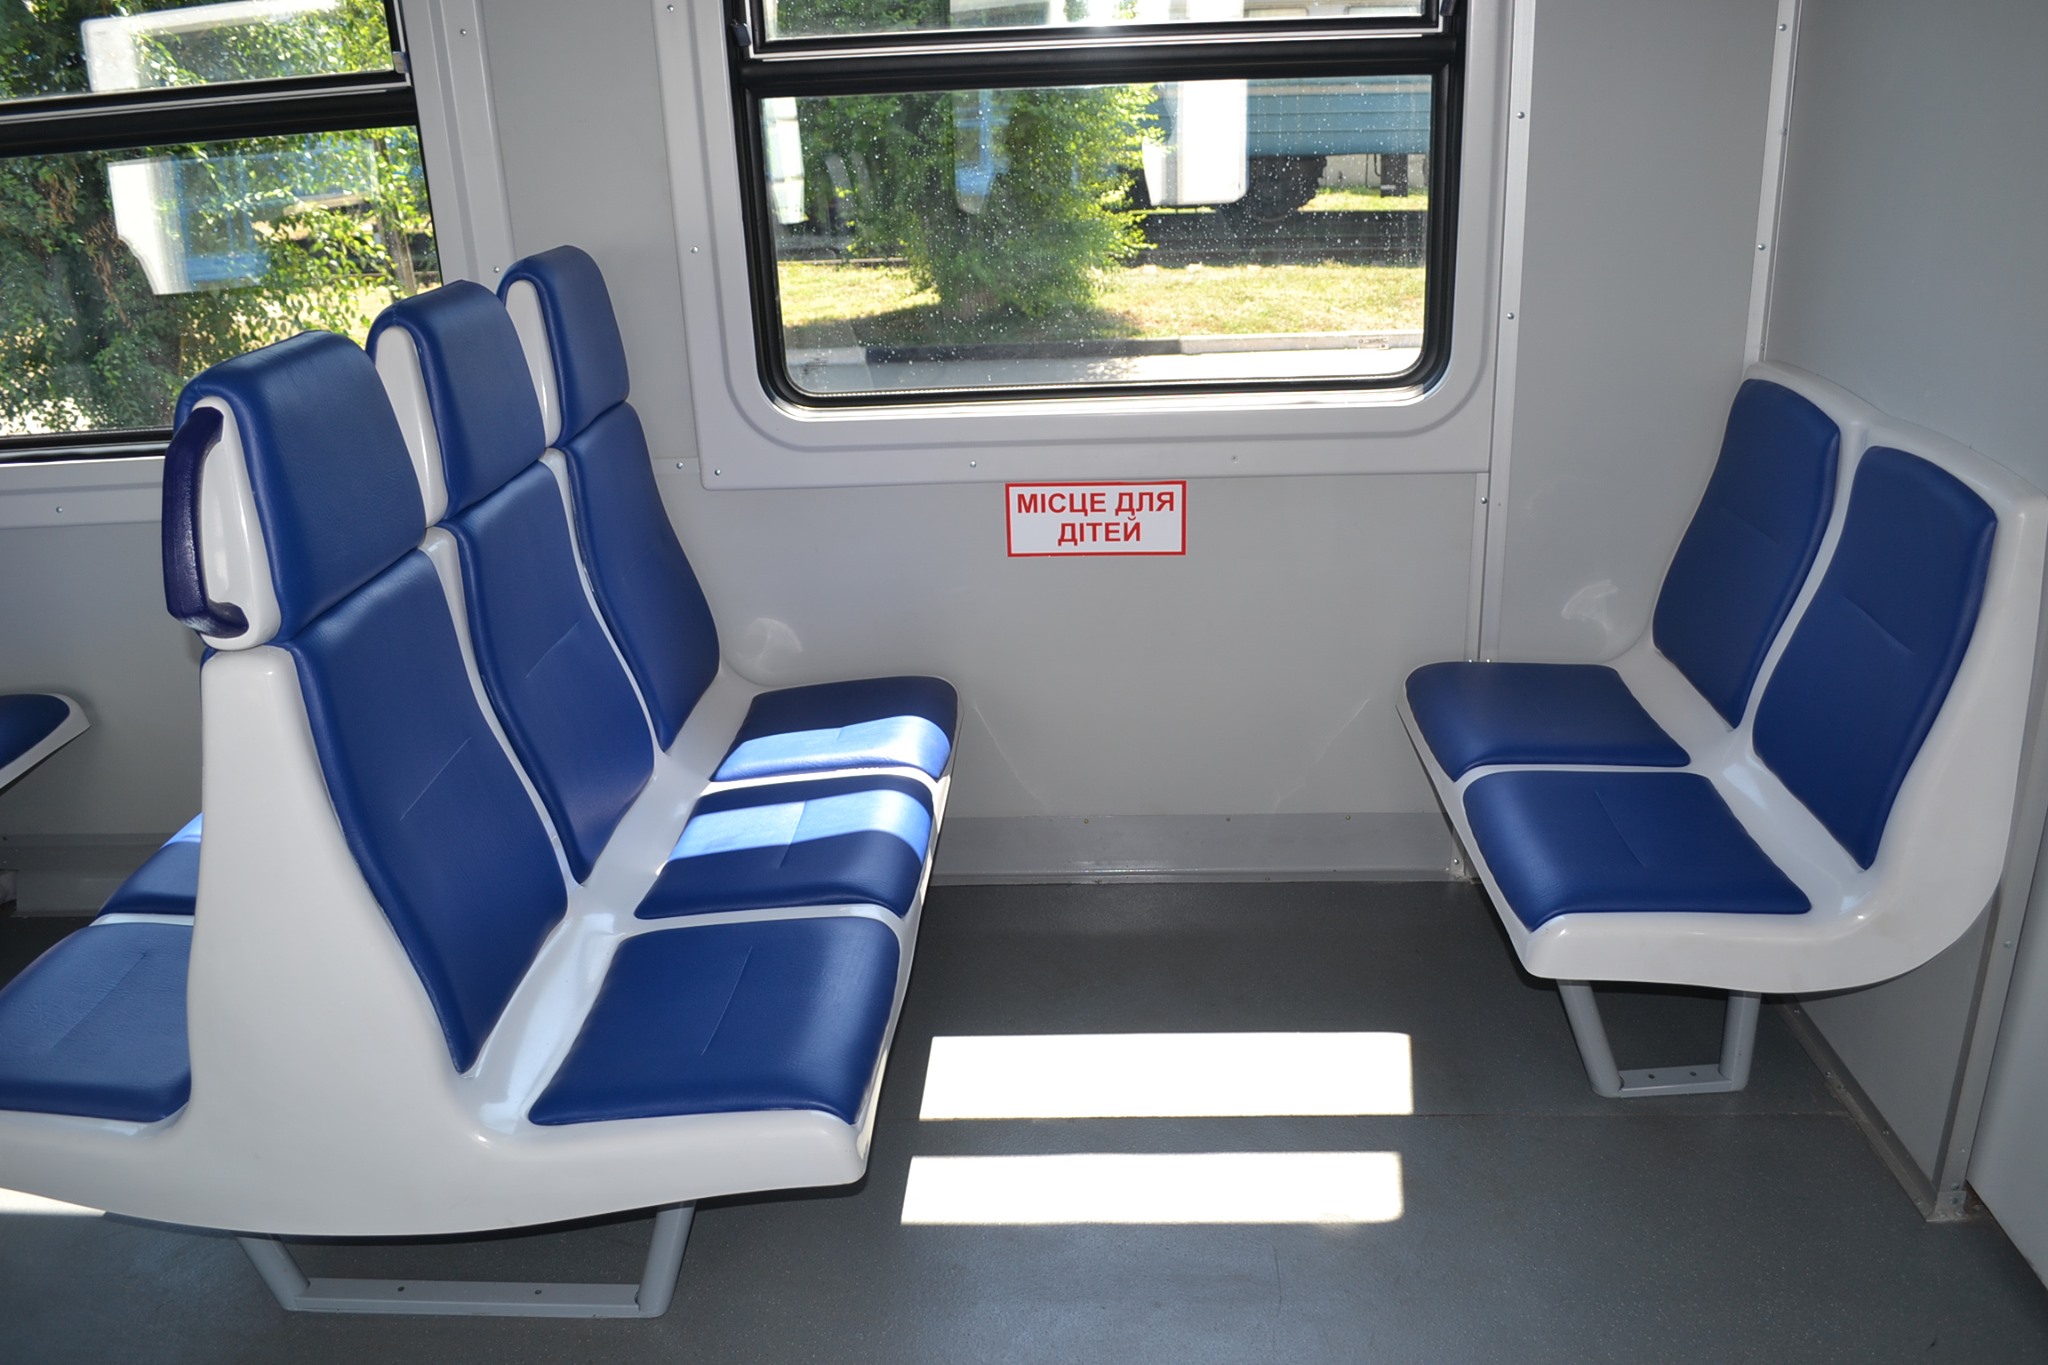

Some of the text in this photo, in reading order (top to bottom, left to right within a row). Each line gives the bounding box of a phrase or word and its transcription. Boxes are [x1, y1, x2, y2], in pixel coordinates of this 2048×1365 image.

[1017, 491, 1175, 517] МІСЦЕ ДЛЯ
[1058, 517, 1142, 546] ДІТЕЙ
